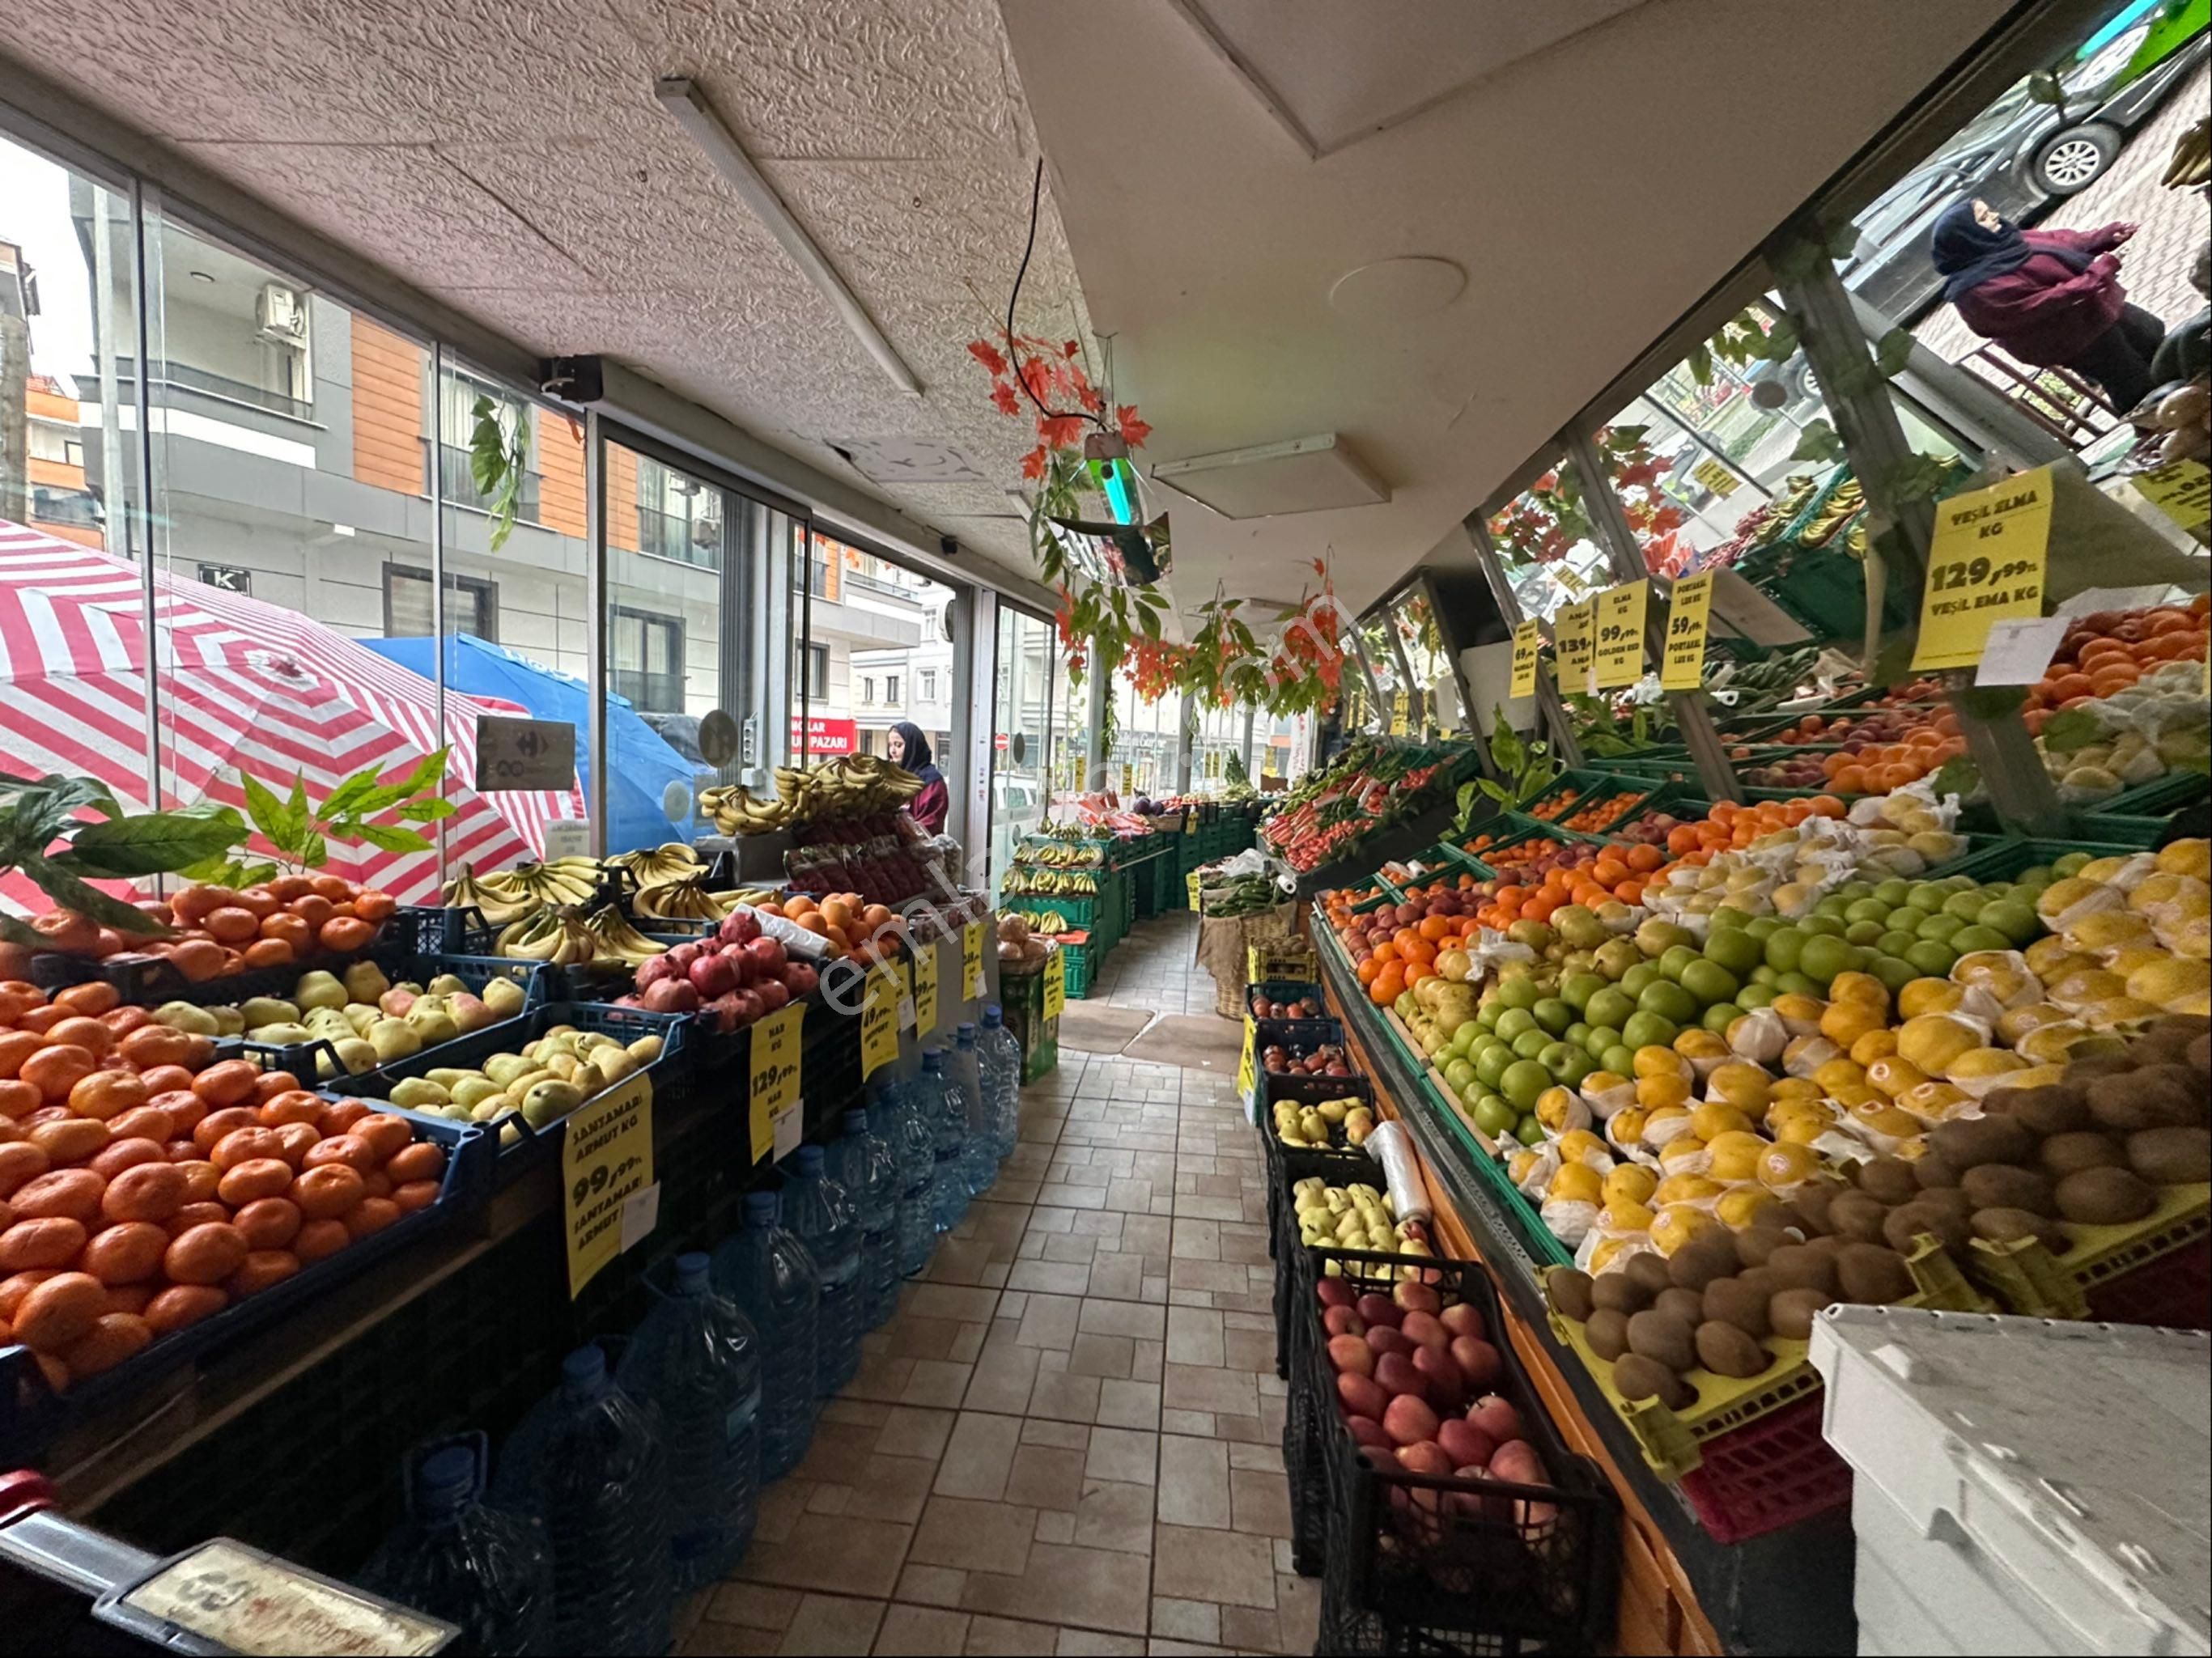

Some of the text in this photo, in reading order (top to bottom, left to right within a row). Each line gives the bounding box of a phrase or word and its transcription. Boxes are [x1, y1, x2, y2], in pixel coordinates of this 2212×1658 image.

[1951, 490, 2037, 526] YEŞİL ELMA
[1980, 522, 2003, 539] KG
[214, 570, 236, 590] K
[1613, 593, 1632, 604] ELMA
[1931, 586, 2038, 616] YEŞİL EMA KG
[810, 736, 847, 749] PAZARI
[769, 1023, 785, 1038] NAR
[768, 1090, 782, 1105] NAR
[575, 1115, 638, 1163] ARMUT KG
[579, 1210, 619, 1250] ARMUT
